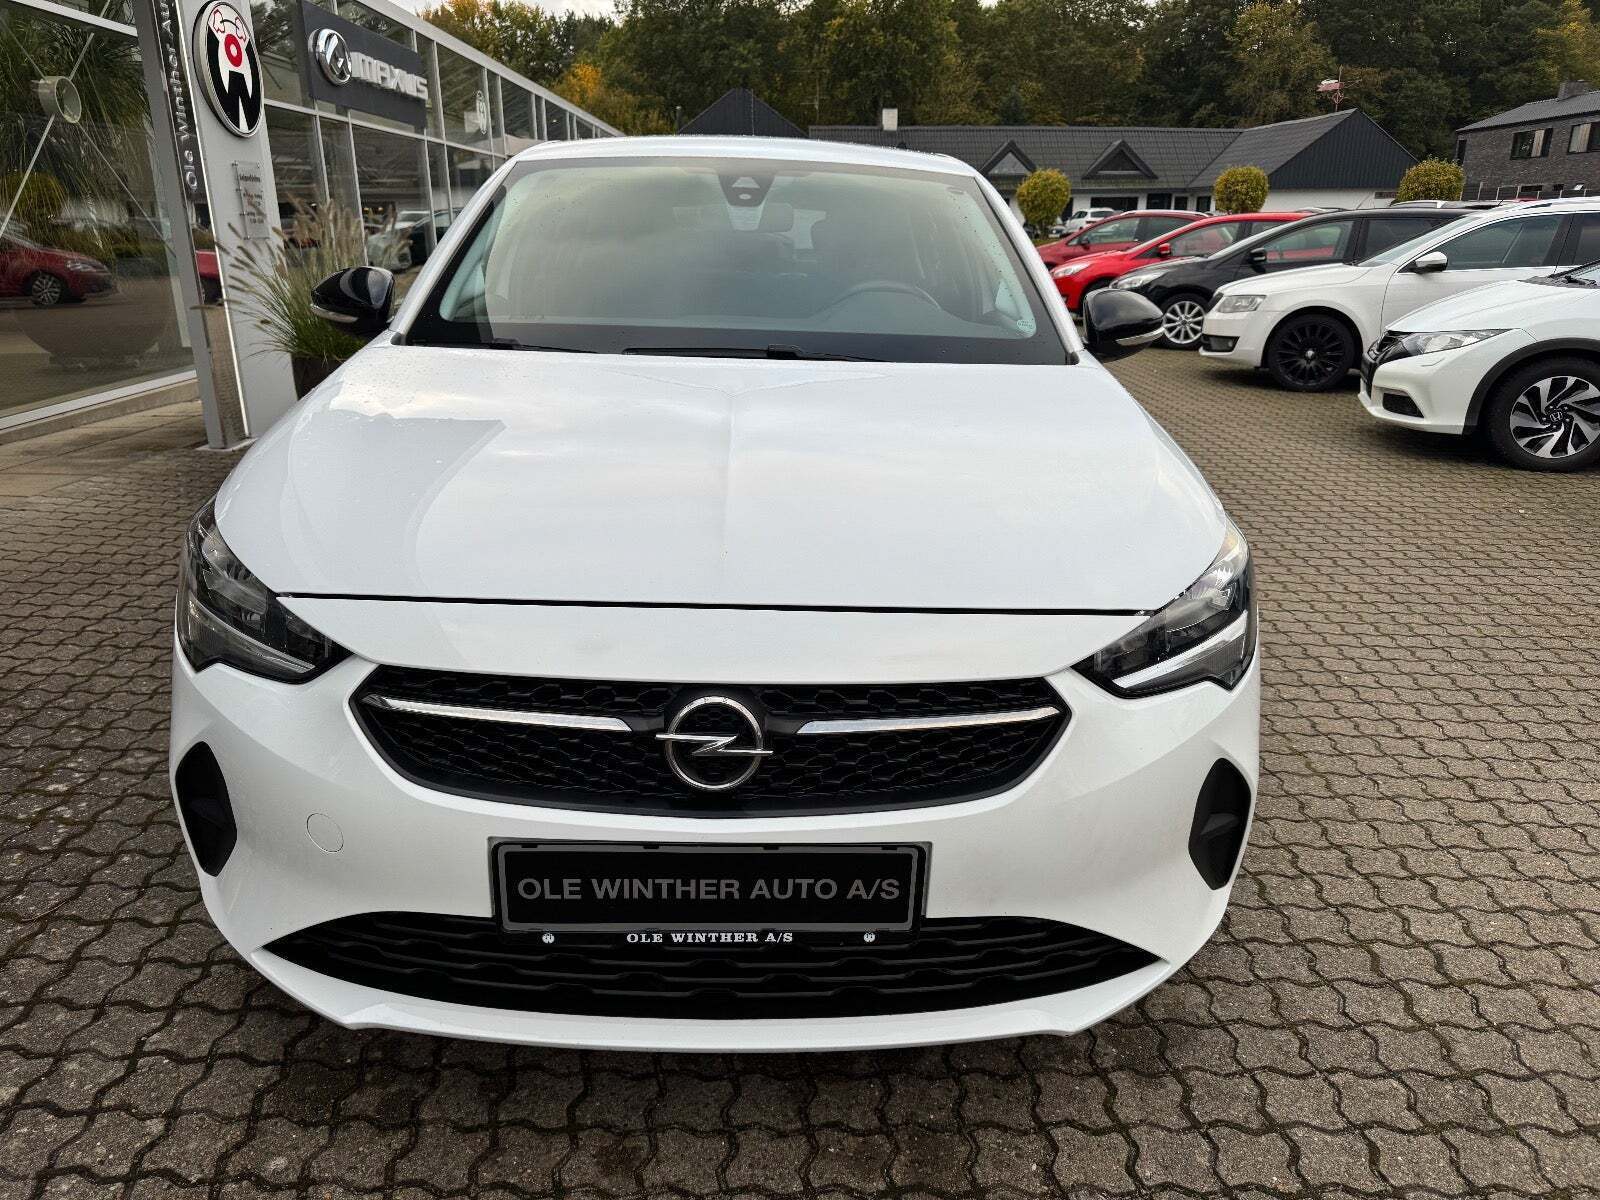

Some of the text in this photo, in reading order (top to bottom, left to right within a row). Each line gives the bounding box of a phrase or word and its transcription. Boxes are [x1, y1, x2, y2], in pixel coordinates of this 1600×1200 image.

[350, 51, 428, 100] MAXUS
[517, 877, 900, 900] OLE WINTHER AUTO A/S
[626, 932, 793, 943] OLE WINTHER A/S
